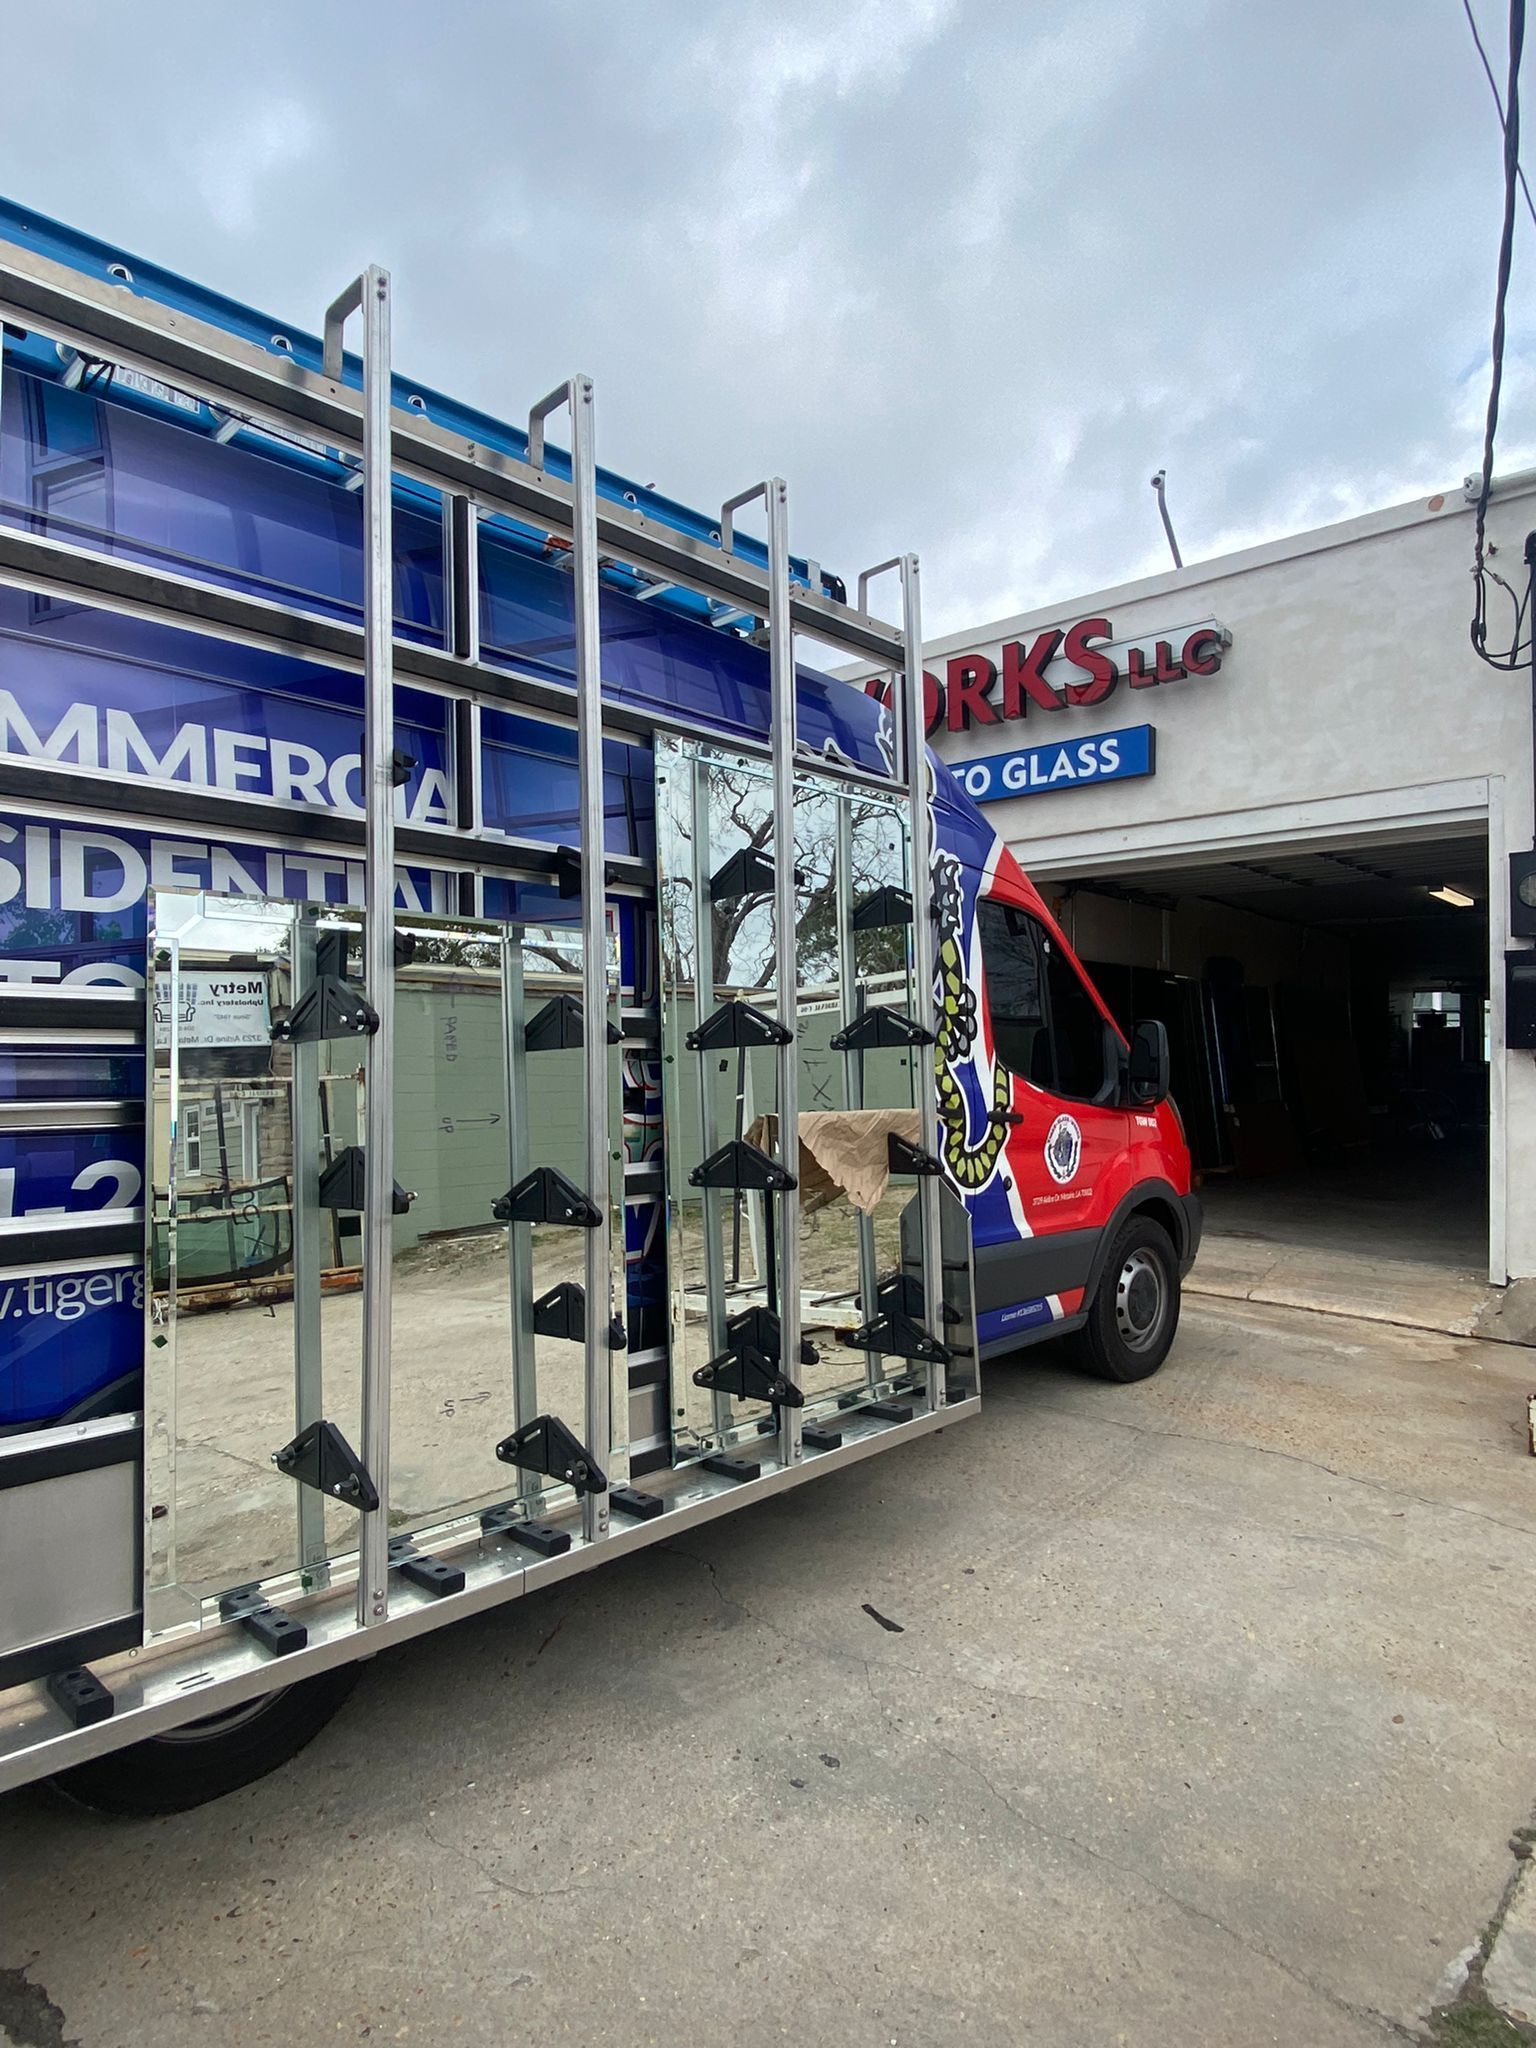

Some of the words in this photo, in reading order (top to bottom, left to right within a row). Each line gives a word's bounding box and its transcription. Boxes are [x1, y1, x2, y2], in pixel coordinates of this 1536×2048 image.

[864, 617, 1119, 739] ORKS
[1127, 628, 1222, 690] LLC
[1001, 737, 1121, 791] GLASS
